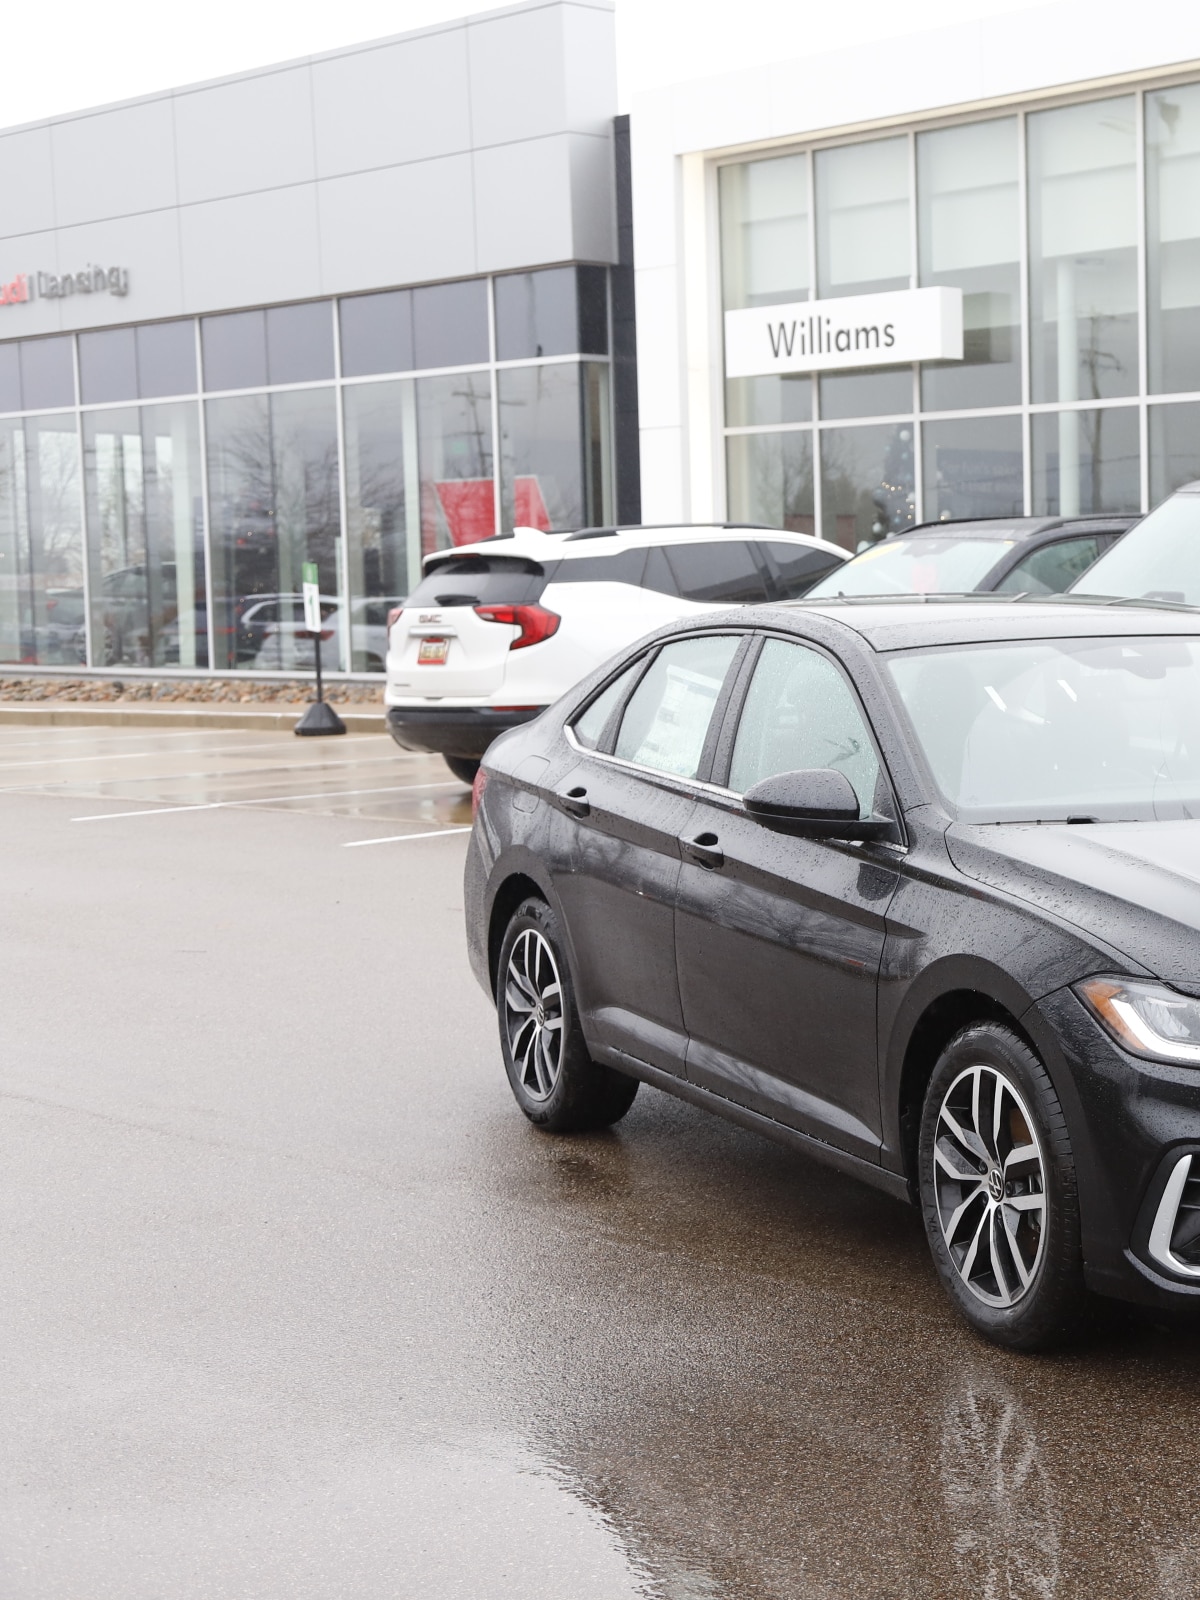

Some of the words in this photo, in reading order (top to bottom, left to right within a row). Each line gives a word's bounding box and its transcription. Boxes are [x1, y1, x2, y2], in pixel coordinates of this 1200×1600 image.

[0, 272, 30, 305] udi
[37, 262, 129, 299] Lansing
[767, 315, 896, 358] Williams
